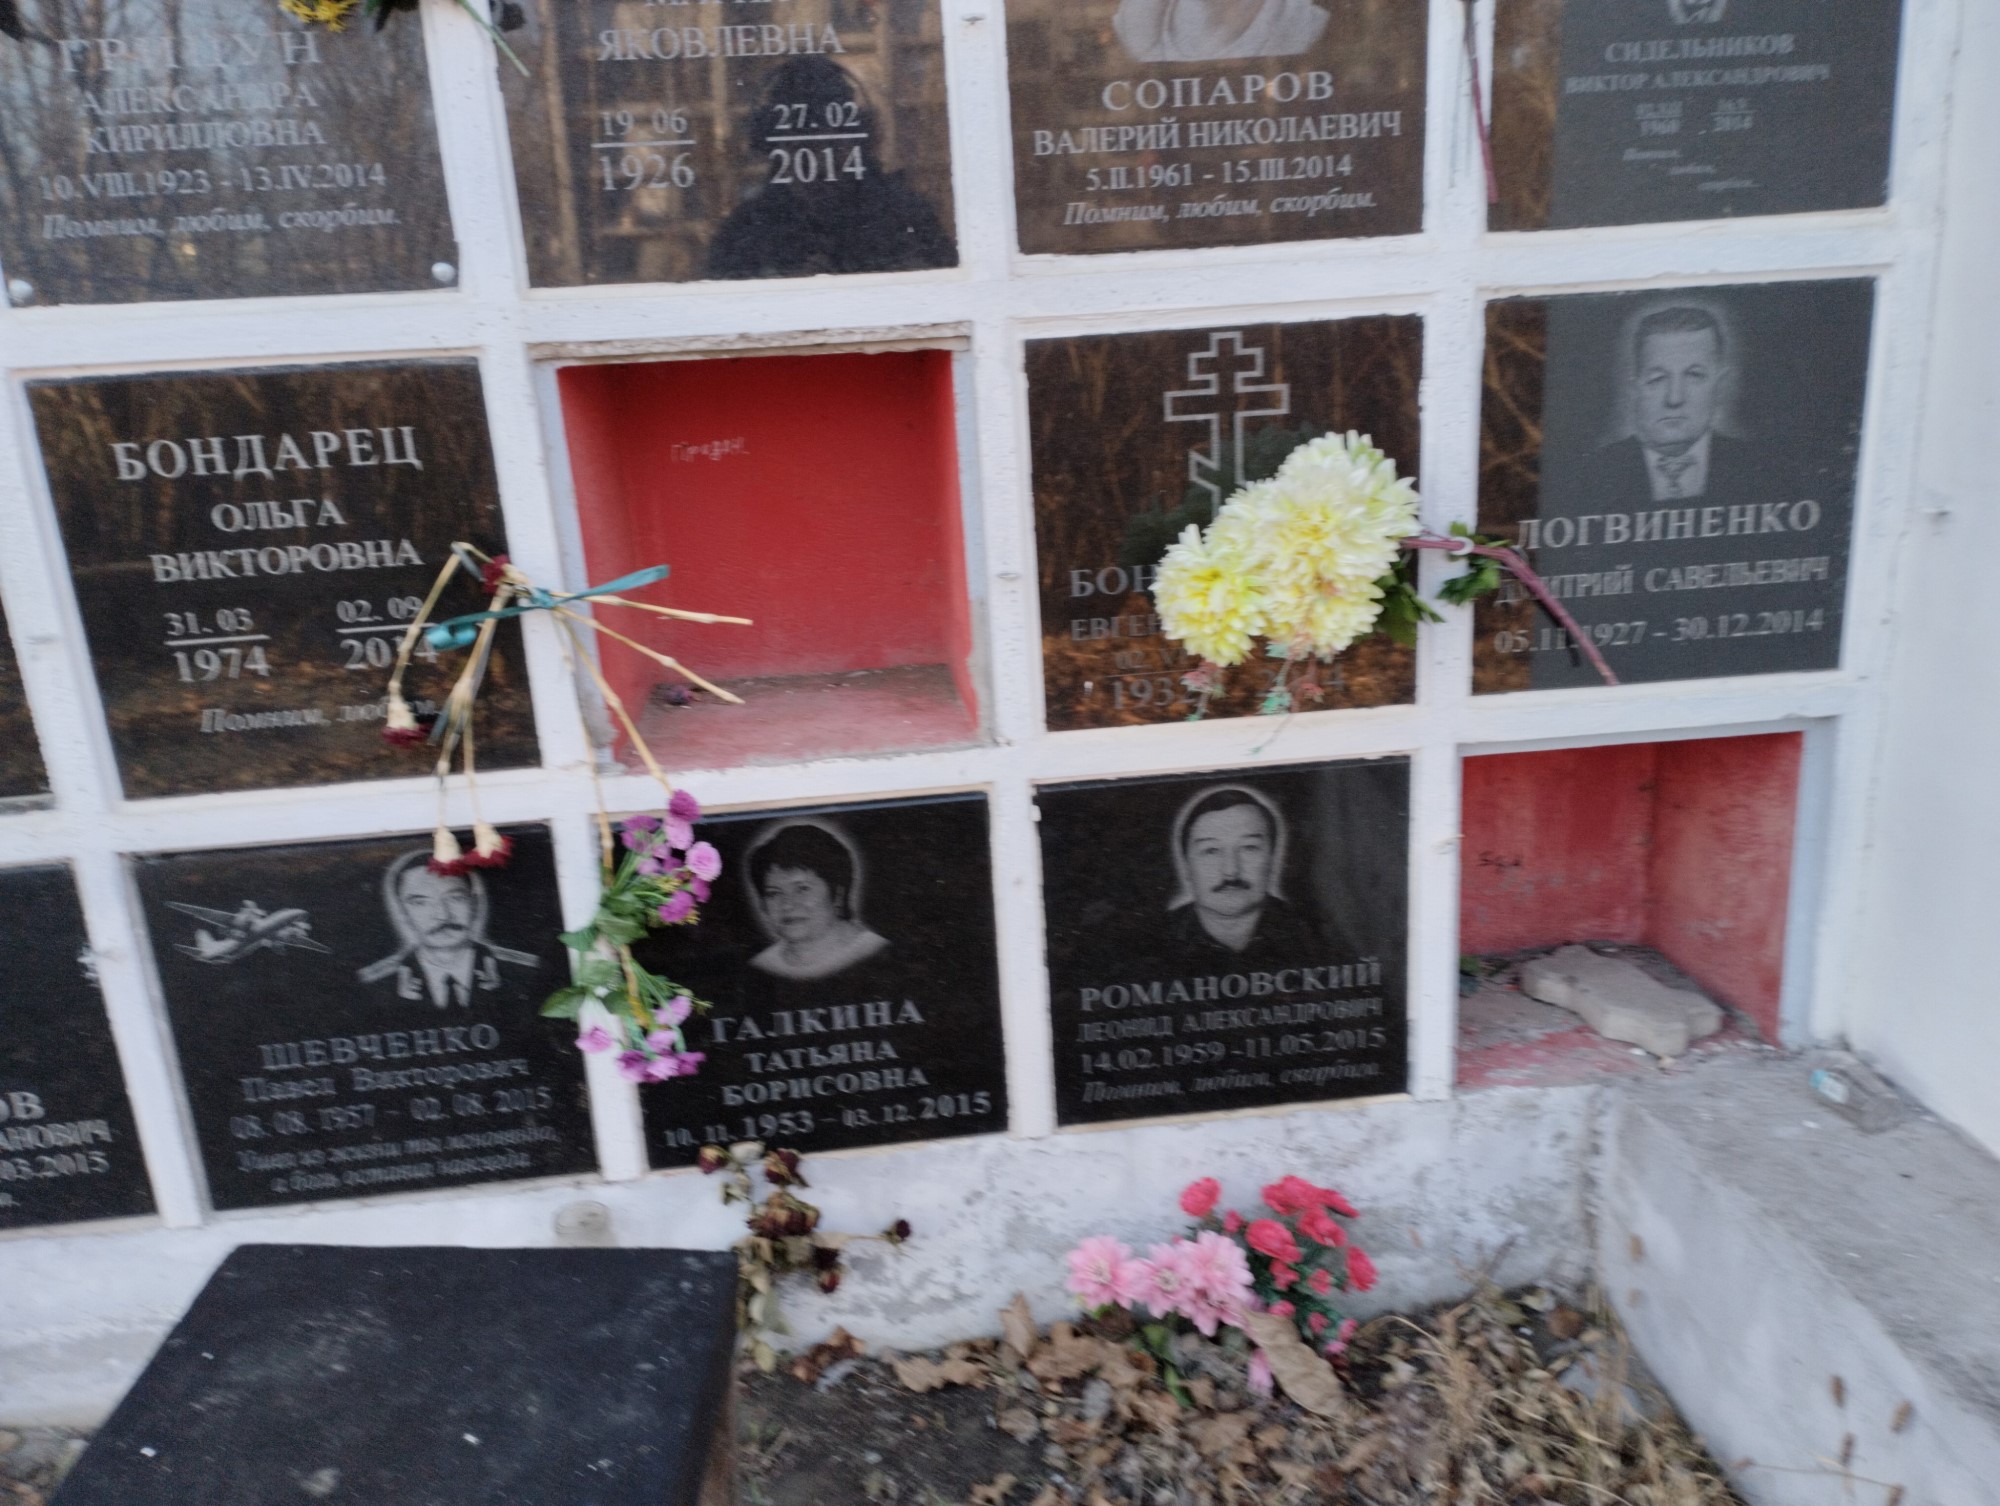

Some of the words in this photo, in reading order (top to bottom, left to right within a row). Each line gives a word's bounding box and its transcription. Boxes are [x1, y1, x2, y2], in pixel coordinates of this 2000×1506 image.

[597, 24, 846, 61] ЯКОВЛЕВНА
[1102, 71, 1334, 111] СОПАРОВ
[87, 119, 327, 154] КИРИЛЛОВНА
[1034, 117, 1181, 156] ВАЛЕРИЙ
[1189, 111, 1402, 148] НИКОЛАЕВИЧ
[600, 153, 695, 190] 1926
[768, 145, 867, 184] 2014
[112, 426, 424, 481] БОНДАРЕЦ
[211, 499, 347, 532] ОЛЬГА
[1517, 500, 1821, 550] ЛОГВИНЕНКО
[150, 538, 425, 583] ВИКТОРОВНА
[1644, 556, 1830, 593] САВЕЛЬЕВИЧ
[1671, 608, 1823, 641] 30.12.2014
[174, 645, 271, 682] 1974
[1079, 956, 1382, 1012] РОМАНОВСКИЙ
[710, 1000, 926, 1043] ГАЛКИНА
[259, 1023, 499, 1070] ШЕВЧЕНКО
[743, 1040, 900, 1073] ТАТЬЯНА
[721, 1067, 930, 1106] БОРИСОВНА
